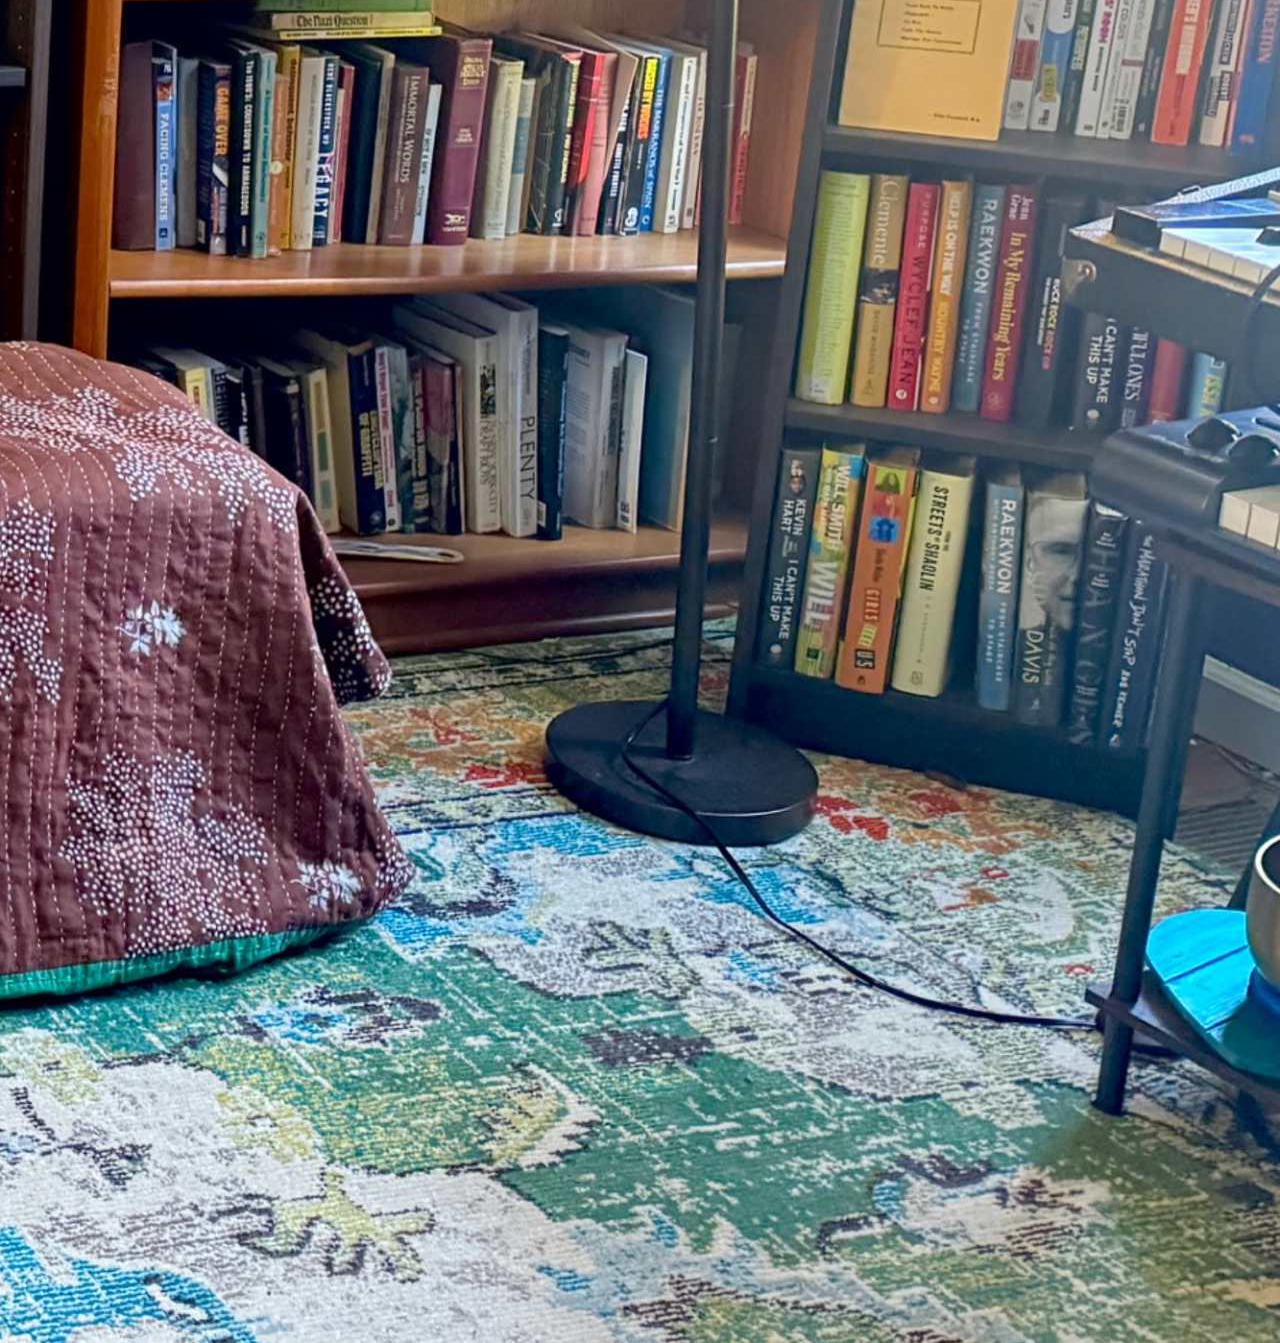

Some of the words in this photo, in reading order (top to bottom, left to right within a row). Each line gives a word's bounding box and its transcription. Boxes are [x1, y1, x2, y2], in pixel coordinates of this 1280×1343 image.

[159, 113, 171, 160] FACING
[313, 152, 335, 218] LEGACY
[872, 181, 903, 266] Clemente
[972, 198, 998, 294] RAEKWON
[1088, 335, 1103, 363] THIS
[1101, 325, 1117, 363] CAN'T
[1085, 367, 1099, 385] UP
[1095, 367, 1113, 403] MAKE
[518, 416, 538, 501] PLENTY
[780, 499, 796, 532] HART
[792, 499, 807, 536] KEVIN
[927, 486, 950, 536] STREETS
[918, 543, 939, 591] SHAOLIN
[995, 499, 1017, 595] RAEKWON
[1022, 630, 1045, 684] DAVIS
